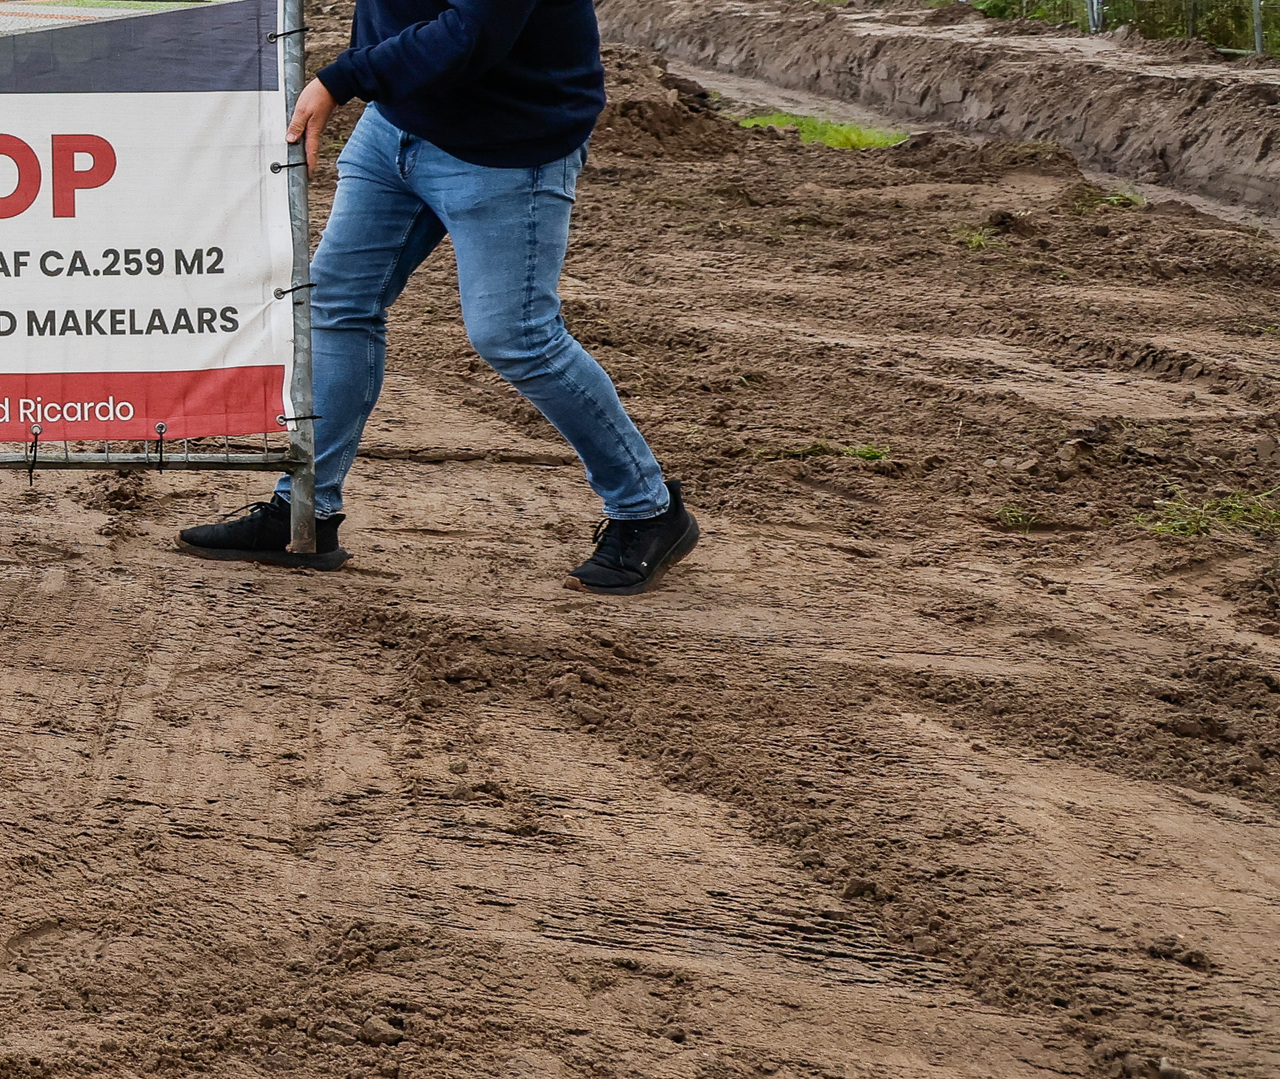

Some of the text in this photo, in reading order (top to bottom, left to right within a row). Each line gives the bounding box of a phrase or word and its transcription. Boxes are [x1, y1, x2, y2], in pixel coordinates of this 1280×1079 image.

[39, 247, 165, 277] CA.259
[174, 246, 225, 275] M2
[26, 306, 239, 337] MAKELAARS
[19, 395, 134, 423] Ricardo
